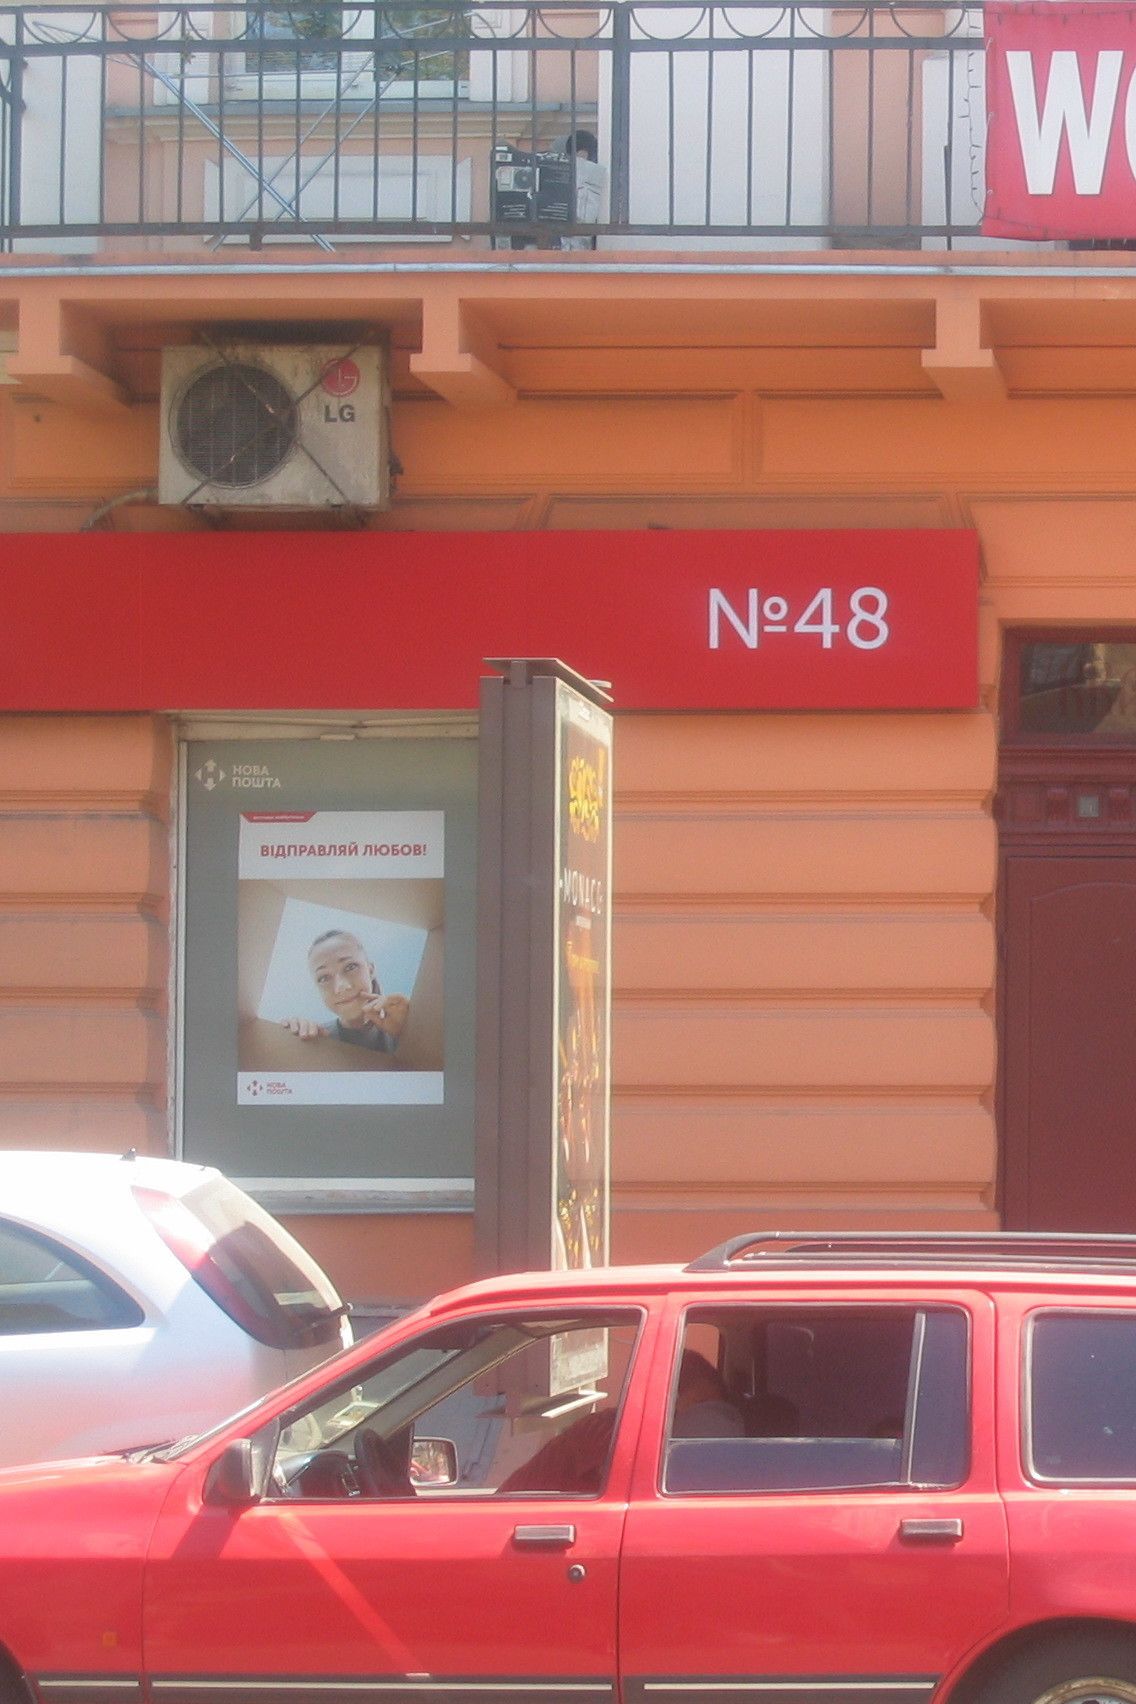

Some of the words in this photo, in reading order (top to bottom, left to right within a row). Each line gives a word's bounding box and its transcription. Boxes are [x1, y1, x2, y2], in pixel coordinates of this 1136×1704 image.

[324, 404, 356, 423] LG
[708, 586, 890, 650] №48
[232, 765, 270, 776] НОВА
[231, 777, 281, 788] ПОШТА
[259, 842, 358, 858] ВІДПРАВЛЯЙ
[363, 843, 427, 857] ЛЮБОВ!
